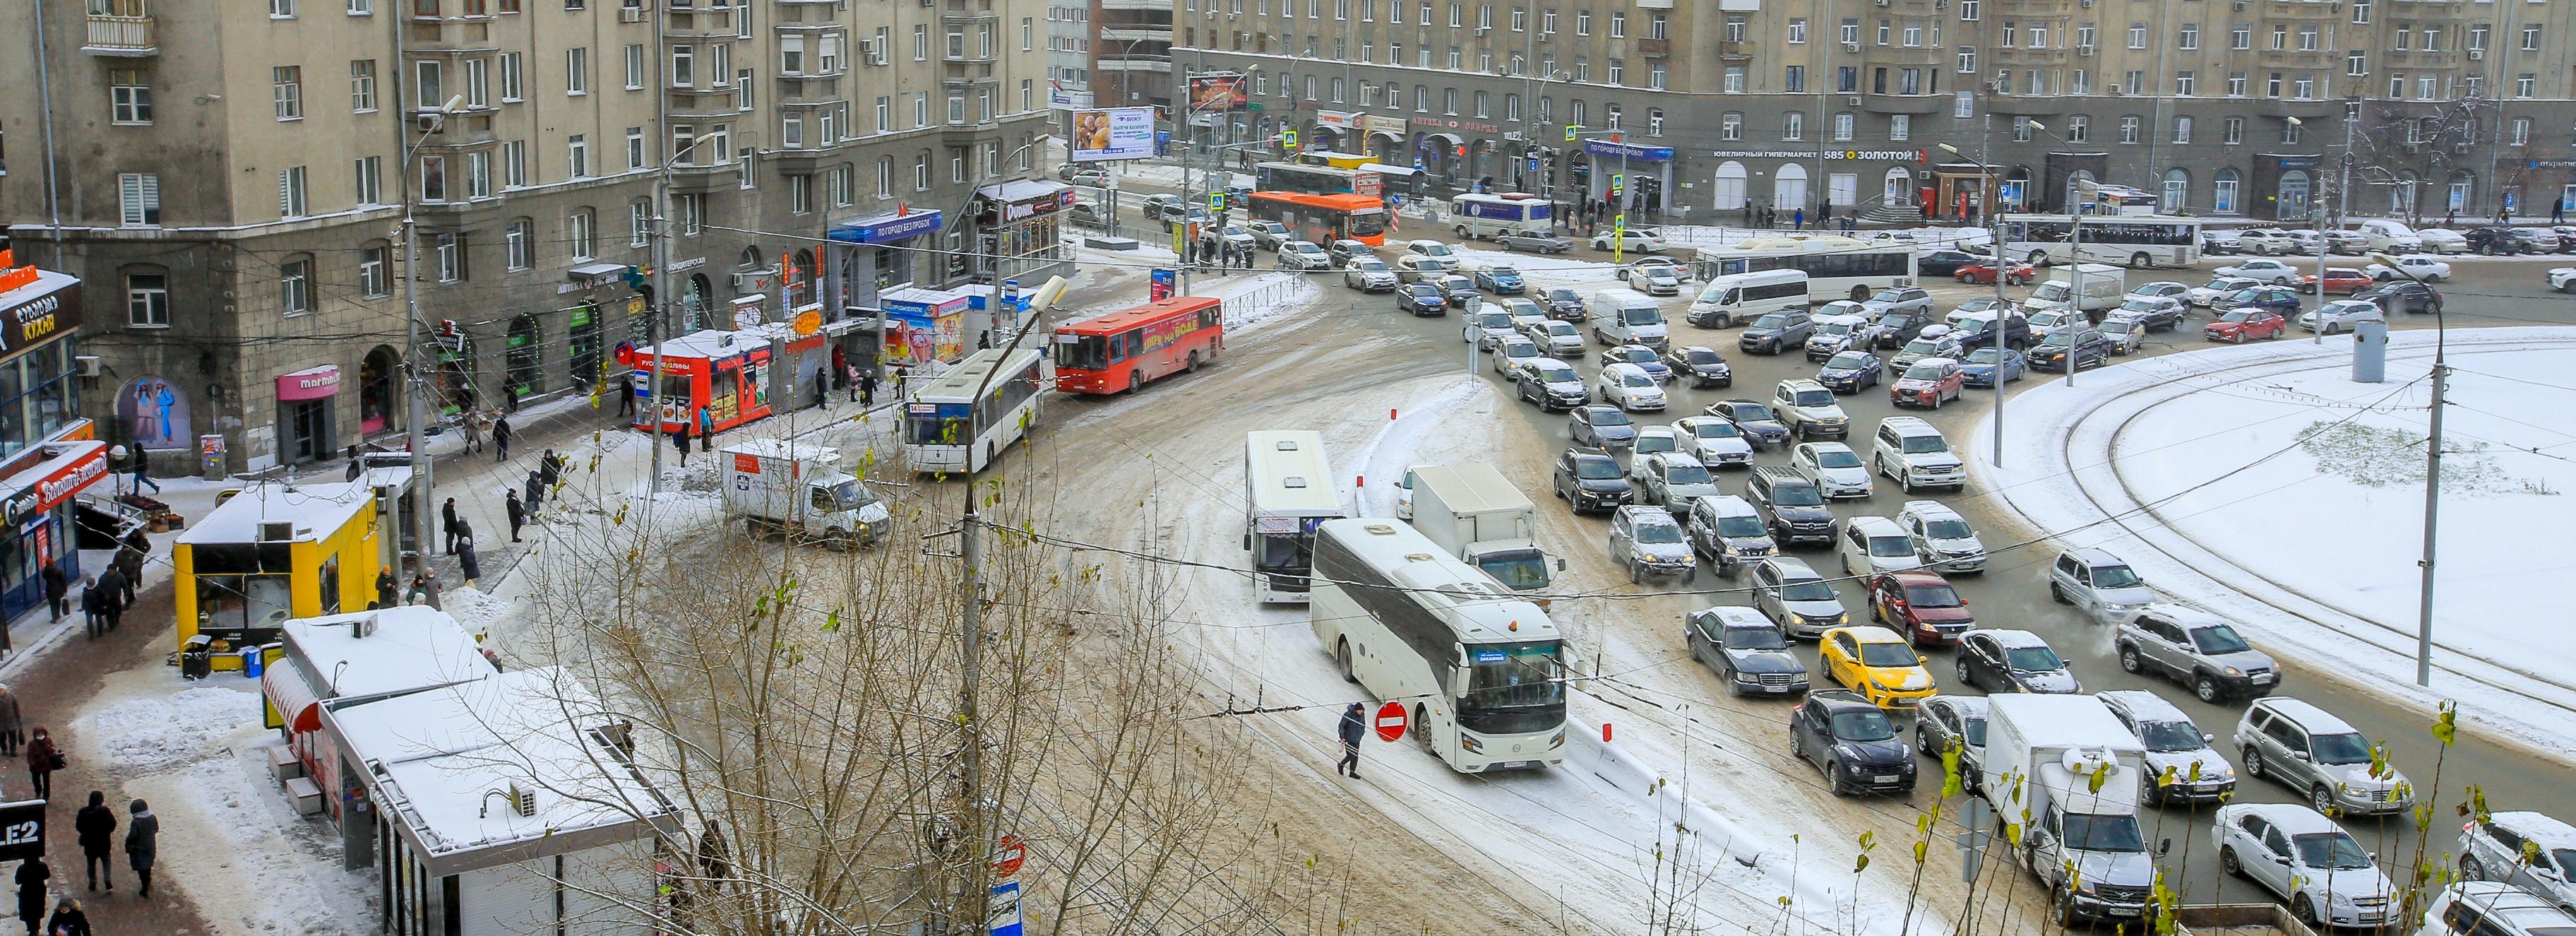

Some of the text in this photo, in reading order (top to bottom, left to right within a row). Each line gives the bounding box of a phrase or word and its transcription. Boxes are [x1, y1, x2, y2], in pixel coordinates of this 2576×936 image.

[1412, 117, 1443, 127] АПТЕКА
[1597, 145, 1616, 154] ГОРОДУ
[1824, 150, 1844, 160] 585
[1857, 150, 1912, 161] ЗОЛОТОЙ
[1008, 203, 1034, 221] DUDNIK
[878, 219, 931, 237] ПО ГОРОДУ БЕЗ ПРОБОК
[668, 256, 706, 272] КОНДИТЕРСКАЯ
[16, 295, 59, 323] СТОЛОВАЯ
[23, 314, 54, 341] КУХНЯ
